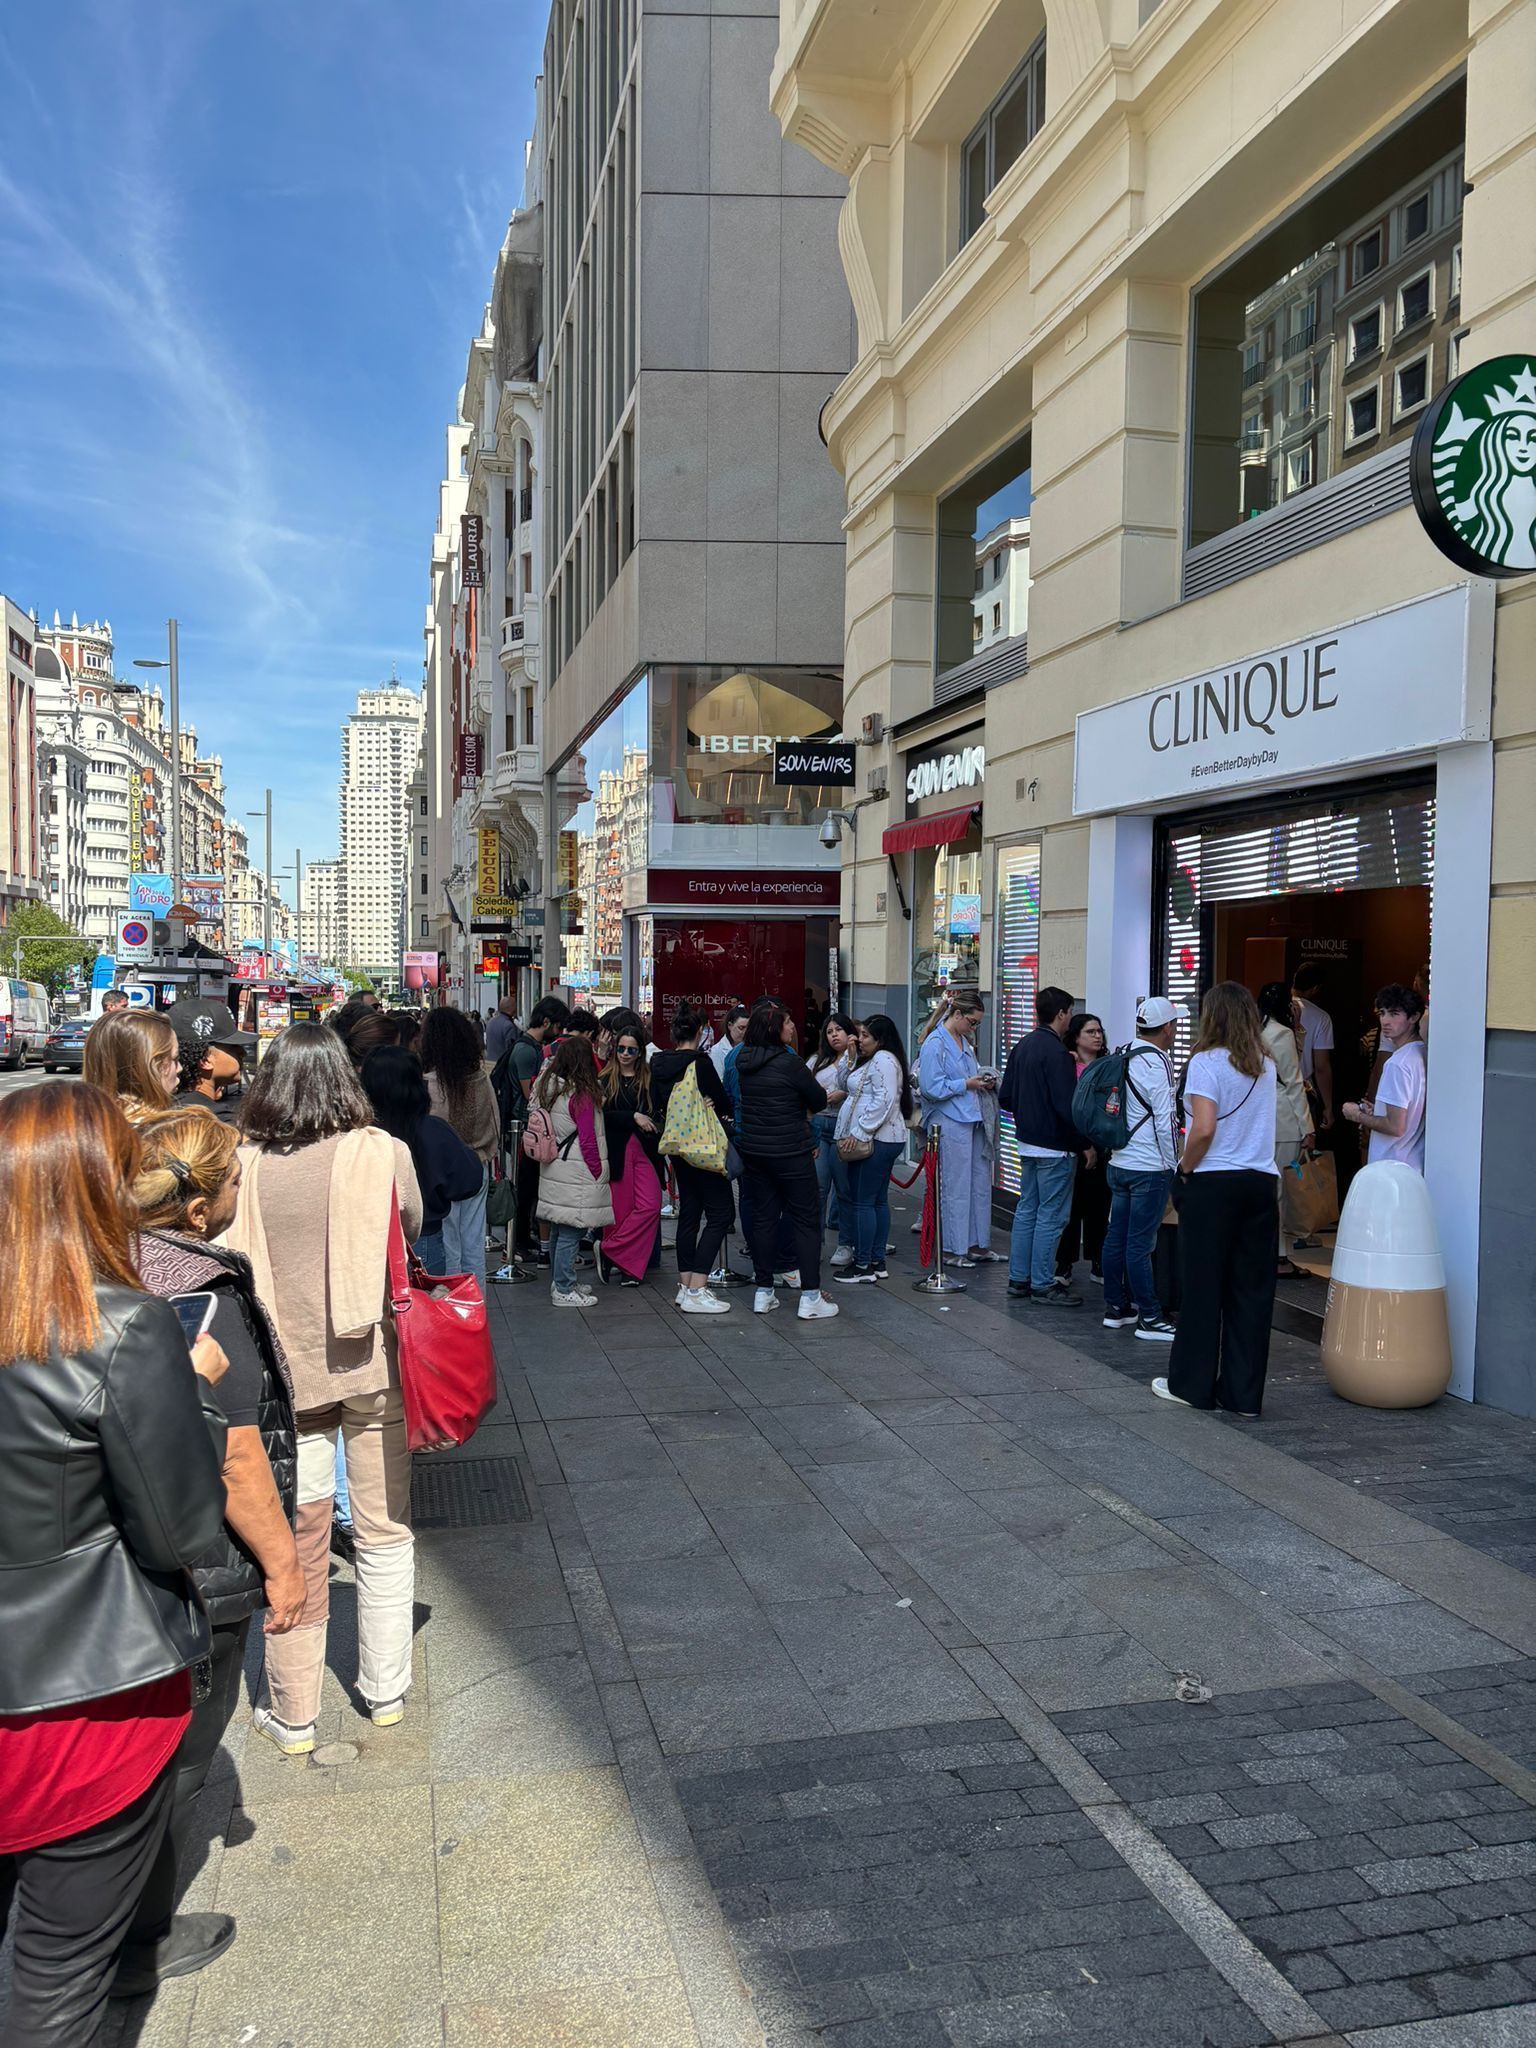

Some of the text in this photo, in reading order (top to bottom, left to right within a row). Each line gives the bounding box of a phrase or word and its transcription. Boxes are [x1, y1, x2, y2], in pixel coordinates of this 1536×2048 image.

[468, 518, 477, 570] LAURIA
[1149, 639, 1339, 752] CLINIQUE
[465, 736, 476, 776] EXCELSIOR
[778, 755, 853, 774] SOUVENIRS
[1190, 749, 1279, 778] #EvenBetterDaybyDay
[131, 774, 141, 833] HOTEL
[481, 829, 496, 894] PELUCAS
[134, 884, 152, 895] SAN
[688, 881, 823, 895] Entra y vive la experiencia
[475, 896, 514, 906] Soledad
[477, 907, 514, 915] Cabello
[1301, 939, 1348, 951] CLINIQUE
